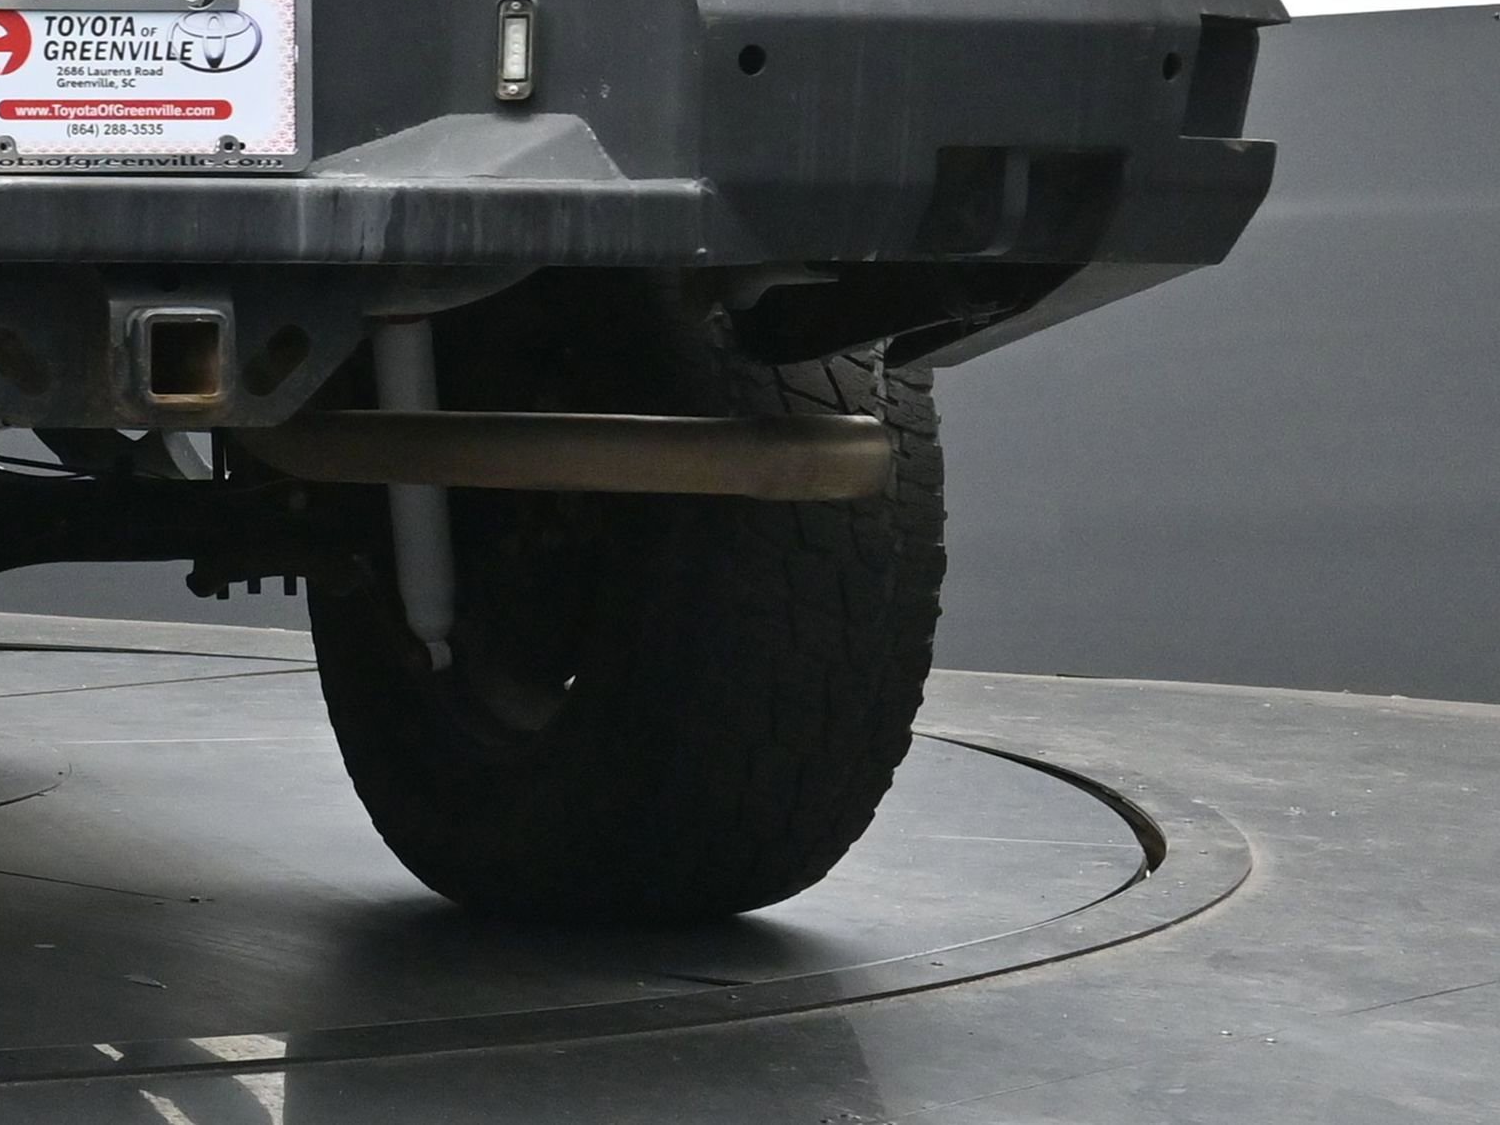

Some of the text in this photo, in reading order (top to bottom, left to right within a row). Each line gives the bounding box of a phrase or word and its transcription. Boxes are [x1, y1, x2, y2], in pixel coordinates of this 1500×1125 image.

[44, 15, 158, 37] TOYOTA OF
[43, 40, 194, 61] GREENVILLE
[56, 66, 164, 76] 2686 Laurens Road
[56, 78, 137, 89] Greenville, SC
[14, 104, 216, 119] www.ToyotaOfGreenville.com
[66, 124, 164, 136] (864) 288-3535
